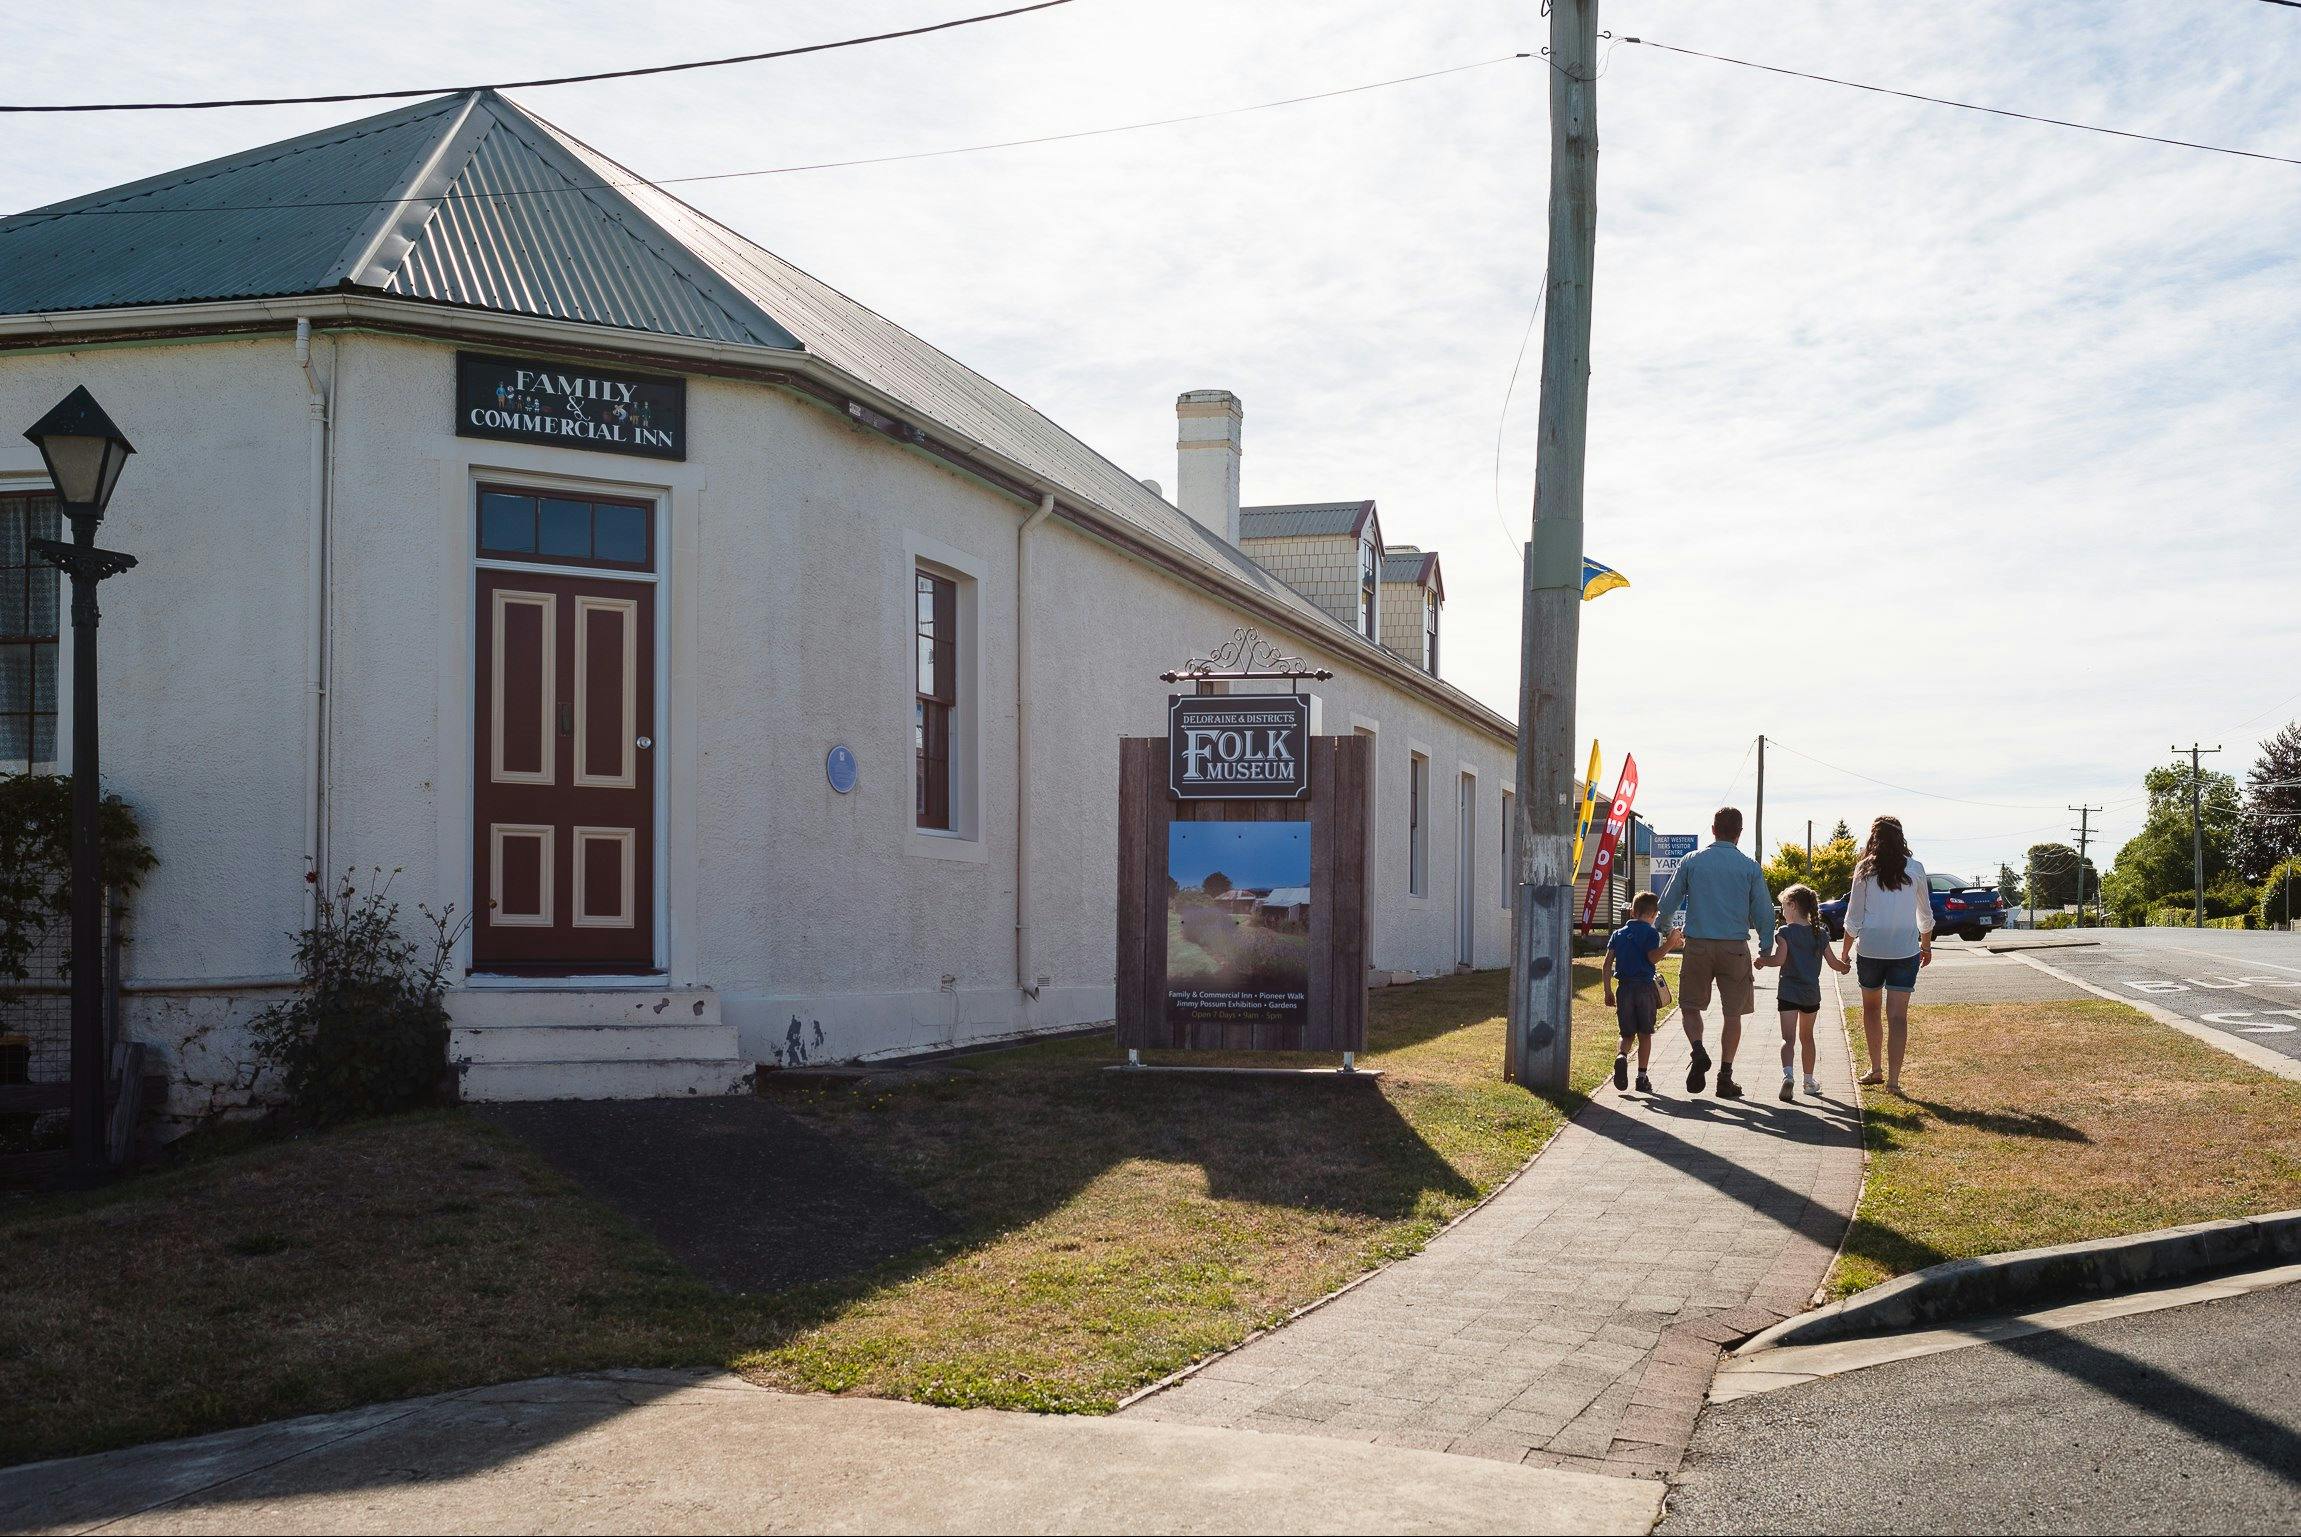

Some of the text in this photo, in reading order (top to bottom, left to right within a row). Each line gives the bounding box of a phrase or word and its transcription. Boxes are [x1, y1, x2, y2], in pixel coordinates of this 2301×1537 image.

[516, 370, 638, 403] FAMILY
[566, 395, 591, 422] &
[470, 408, 673, 448] COMMERCIAL INN
[1183, 714, 1295, 724] DELORAINE & DISTRICTS
[1182, 730, 1295, 780] FOLK
[1206, 761, 1296, 780] MUSEUM
[1606, 779, 1636, 836] NOW
[2121, 976, 2301, 993] BUS
[1168, 990, 1191, 1000] Family
[1199, 991, 1240, 999] Commercial
[1259, 992, 1286, 1000] Pioneer
[1287, 992, 1305, 1000] Walk
[1176, 1000, 1298, 1009] Jimmy Possum Exhibition Gardens
[1191, 1010, 1212, 1020] Open
[1219, 1011, 1237, 1019] Days
[1243, 1011, 1259, 1019] 9am
[1266, 1011, 1282, 1020] 5pm
